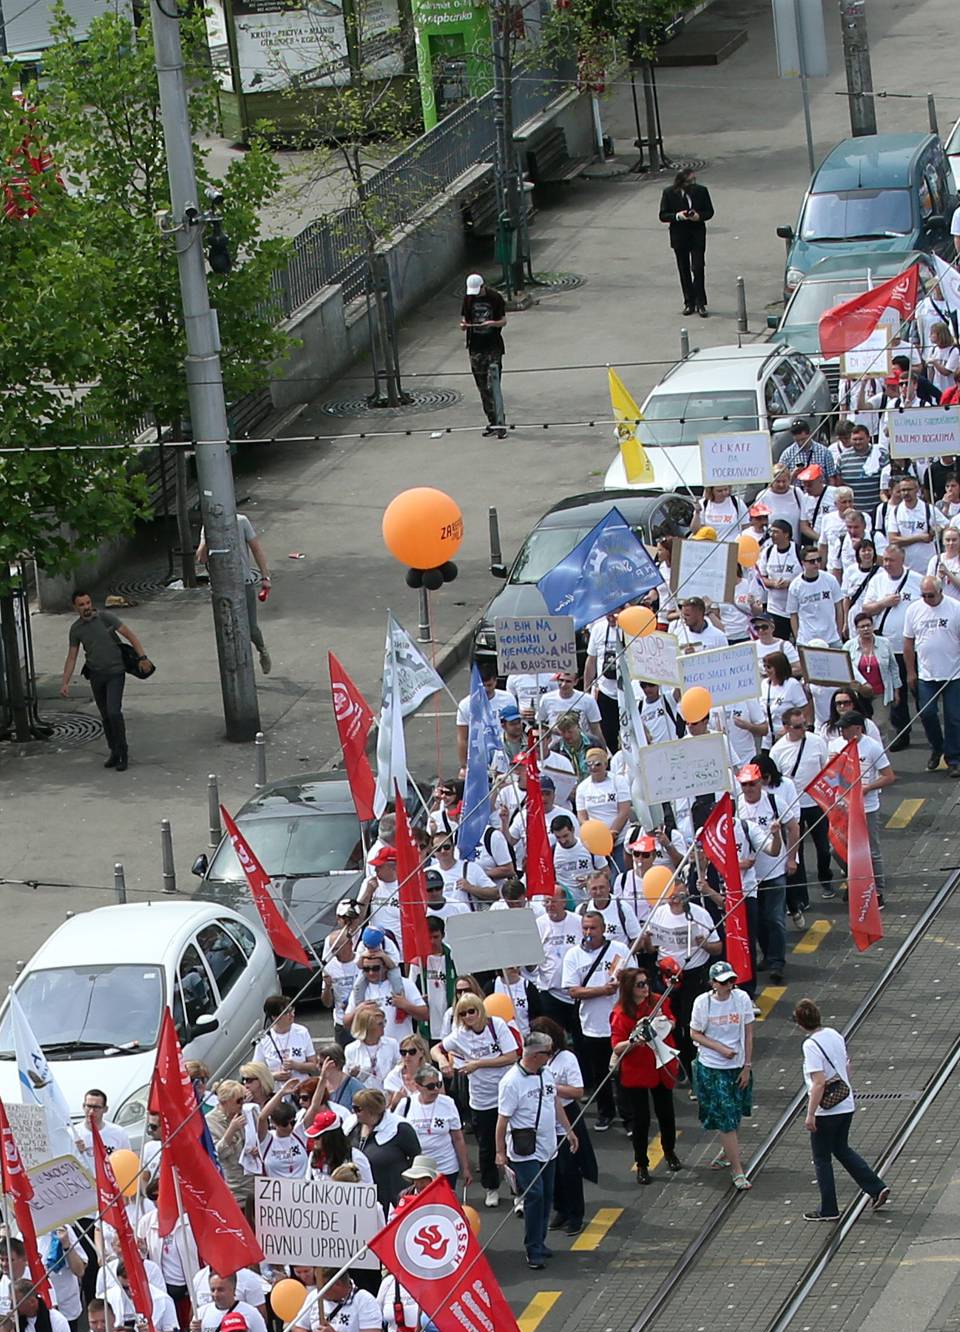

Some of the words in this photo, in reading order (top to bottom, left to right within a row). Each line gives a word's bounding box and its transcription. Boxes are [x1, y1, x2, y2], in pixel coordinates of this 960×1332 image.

[514, 620, 531, 630] BIH
[259, 1179, 282, 1202] ZA
[291, 1181, 376, 1209] UČINKOVITO
[259, 1205, 339, 1233] PRAVOSUĐE
[310, 1237, 368, 1261] UPRAVU
[453, 1220, 467, 1265] SSSH
